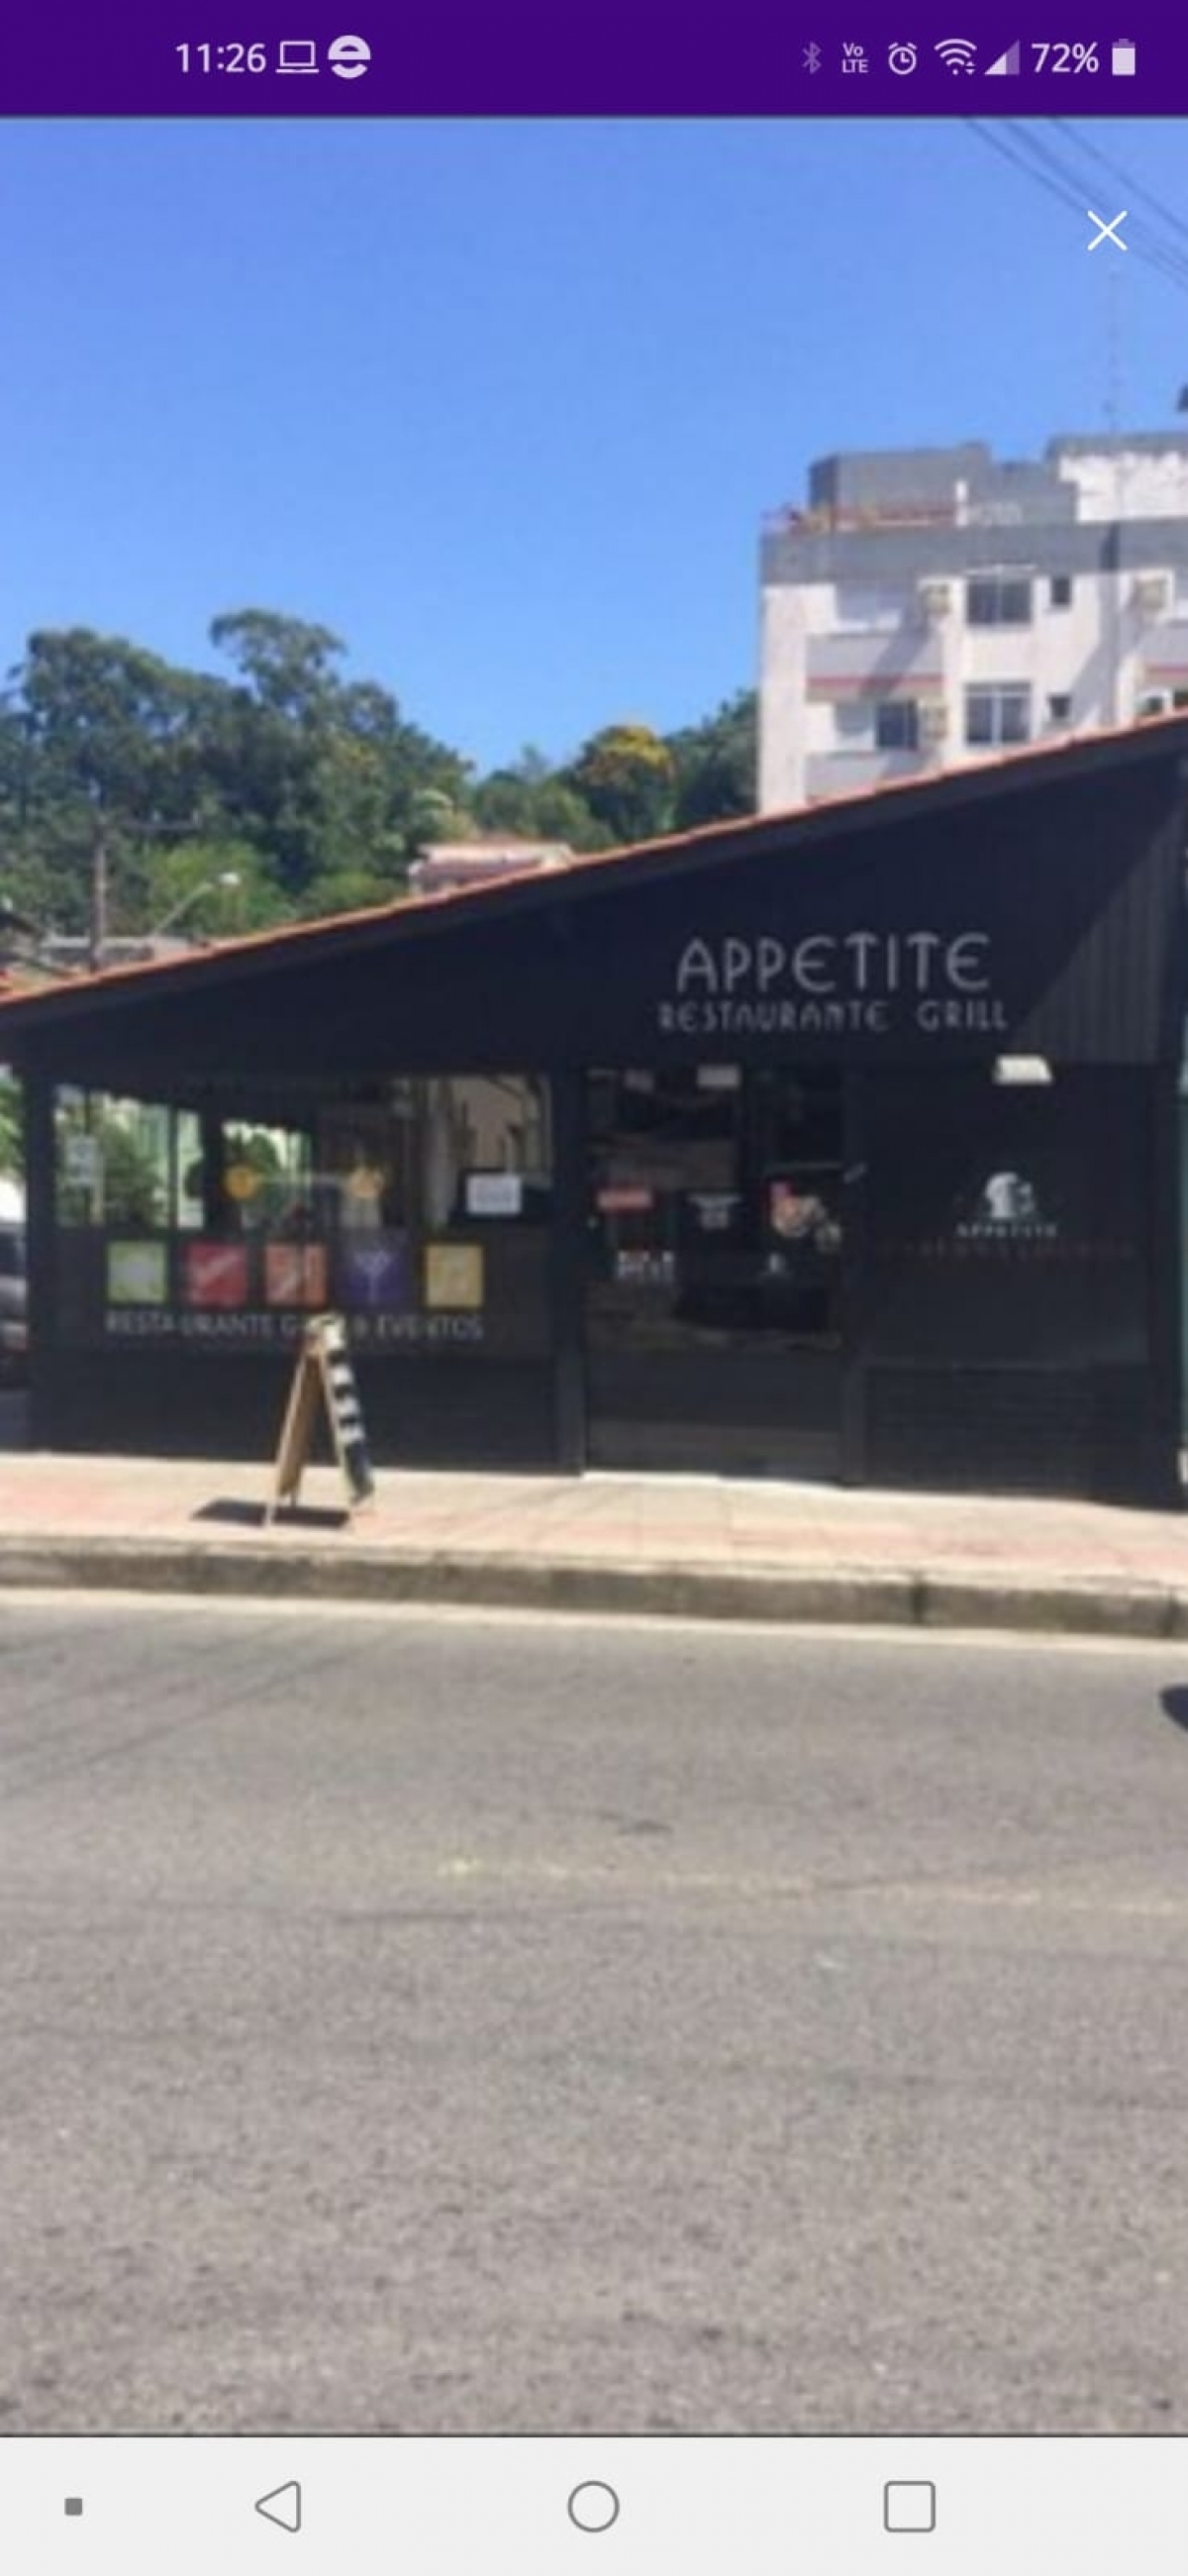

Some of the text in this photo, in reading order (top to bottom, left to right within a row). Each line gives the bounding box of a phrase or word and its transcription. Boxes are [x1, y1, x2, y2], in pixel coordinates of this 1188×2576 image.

[677, 932, 990, 993] APPETITE
[657, 999, 1008, 1032] RESTAURANTE GRILL
